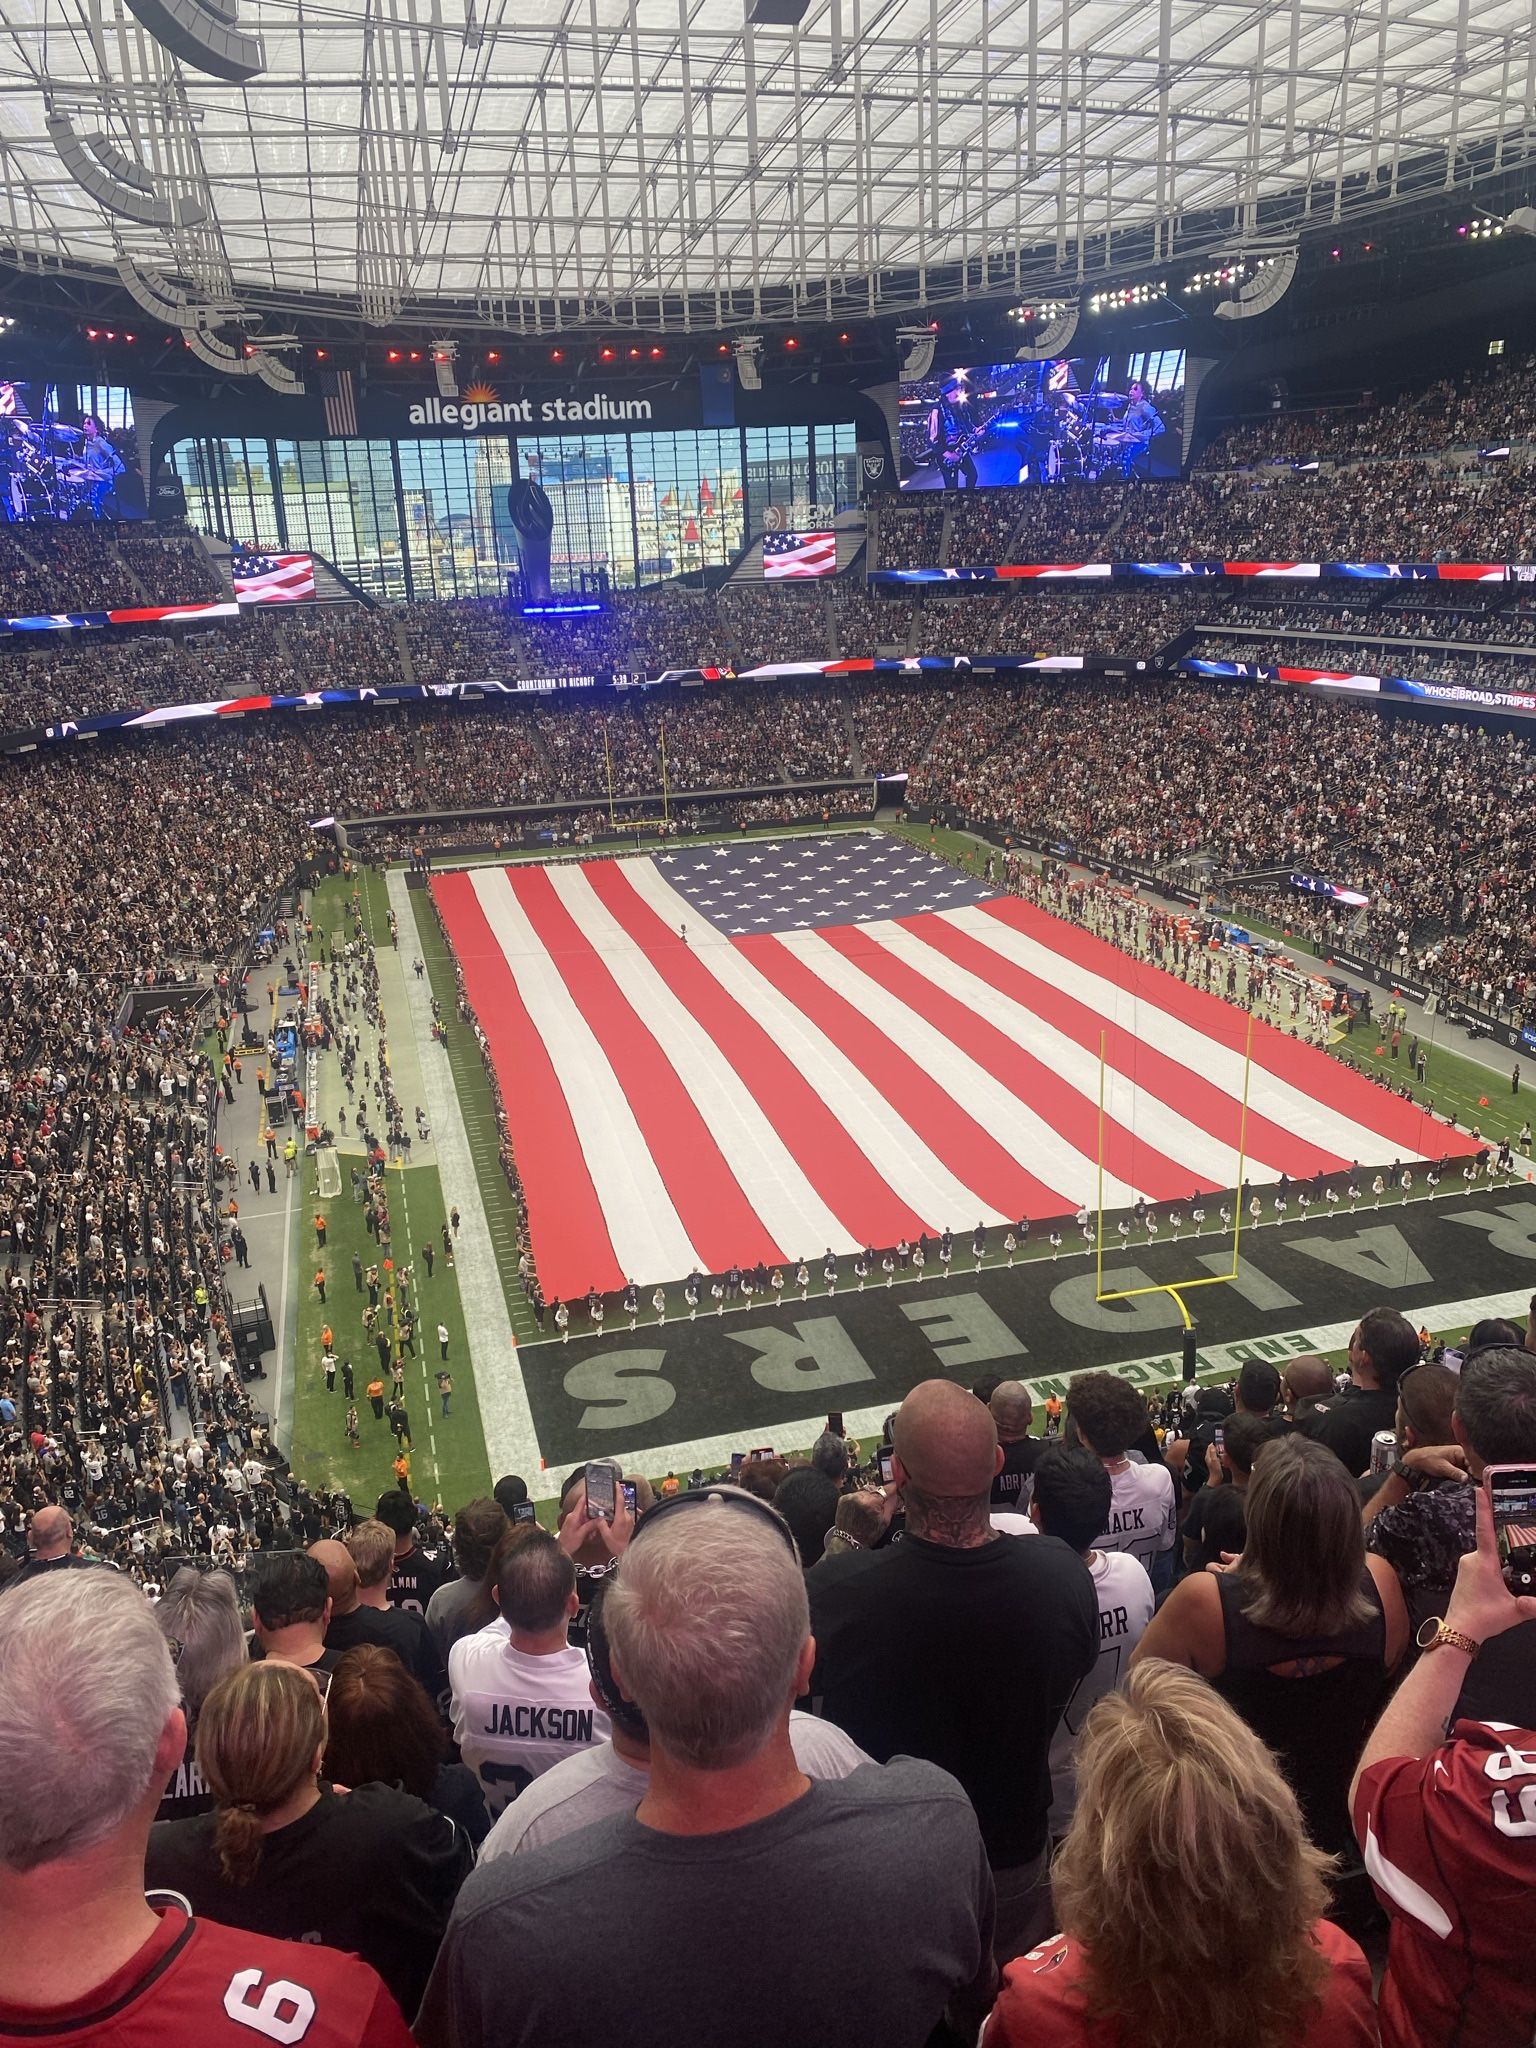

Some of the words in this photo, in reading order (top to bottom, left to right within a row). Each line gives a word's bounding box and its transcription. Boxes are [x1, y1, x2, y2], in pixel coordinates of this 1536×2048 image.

[409, 397, 533, 430] allegiant
[541, 394, 652, 422] stadium
[158, 487, 176, 495] Ford
[788, 504, 835, 520] MGM
[517, 679, 556, 690] COUNTDOWN
[559, 678, 567, 688] TO
[569, 676, 595, 688] KICKOFF
[1424, 685, 1458, 699] WHOSE
[1458, 688, 1493, 703] BROAD
[1494, 694, 1536, 709] STRIPES
[1225, 1334, 1319, 1363] END
[387, 1576, 418, 1591] LMAN
[484, 1704, 593, 1742] JACKSON
